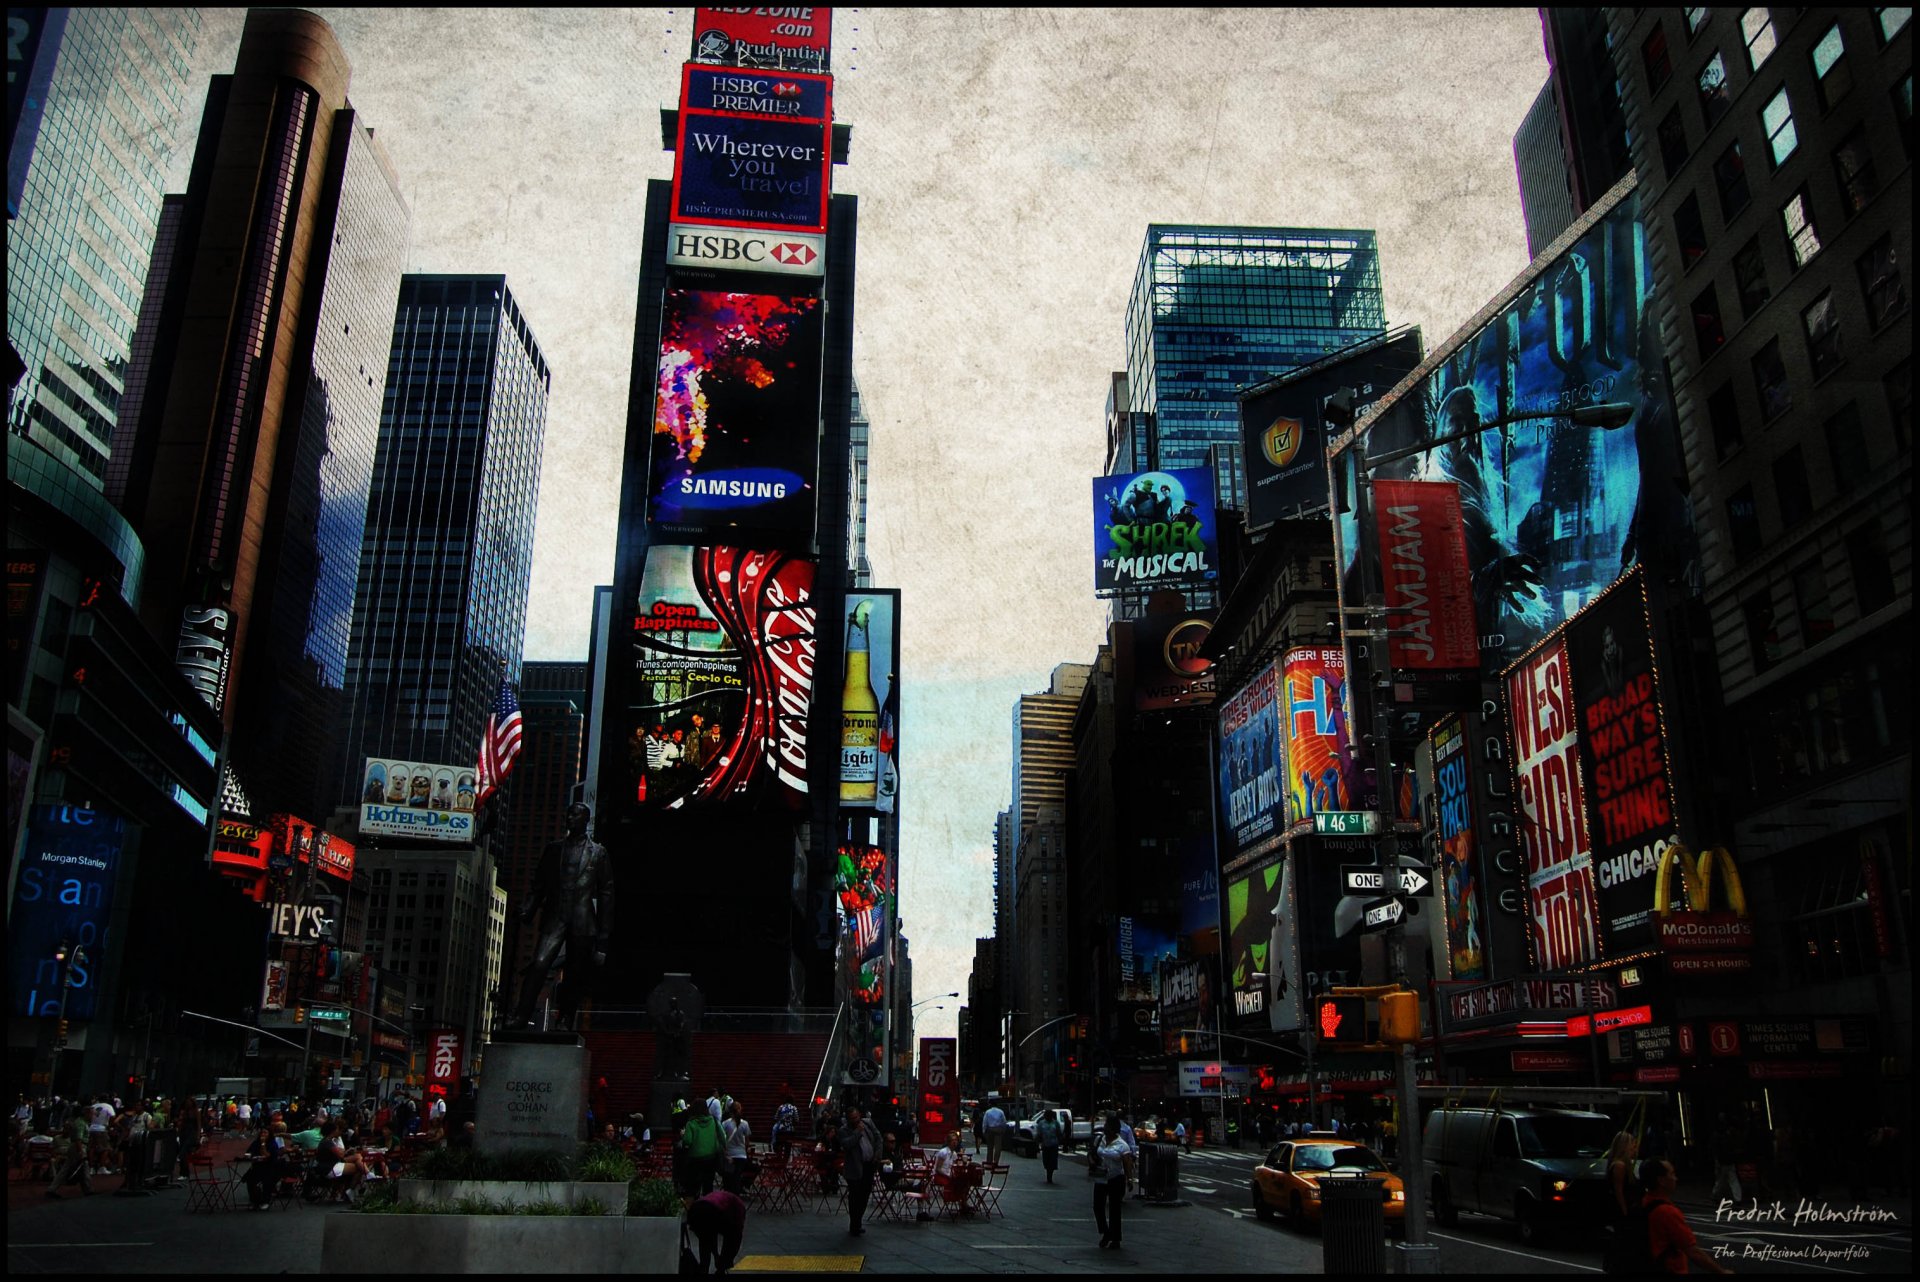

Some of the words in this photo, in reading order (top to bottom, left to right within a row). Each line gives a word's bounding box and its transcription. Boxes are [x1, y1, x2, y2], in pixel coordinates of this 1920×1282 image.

[770, 23, 813, 37] .com
[734, 39, 826, 60] Prudential
[712, 76, 768, 95] HSBC
[712, 94, 801, 115] PREMIER
[693, 132, 815, 161] Wherever
[729, 158, 775, 177] you
[740, 175, 809, 196] travel
[675, 234, 766, 262] HSBC
[1536, 418, 1578, 446] PRINC
[681, 478, 786, 499] SAMSUNG
[1445, 494, 1460, 533] WORLD
[1105, 519, 1206, 558] SHREK
[1449, 536, 1464, 558] THE
[1102, 559, 1115, 569] THE
[1114, 552, 1209, 581] MUSICAL
[1453, 563, 1466, 577] OF
[1386, 505, 1435, 661] JAMJAM
[1438, 570, 1457, 618] SQUARE
[652, 601, 698, 617] Open
[633, 615, 720, 631] Happiness
[1455, 580, 1475, 659] CROSSROADS
[1172, 641, 1201, 660] TN
[1444, 623, 1460, 660] TIMES
[1322, 650, 1344, 661] BES
[1324, 661, 1343, 669] 200
[635, 660, 737, 672] iTunes.com/openhappiness
[215, 648, 230, 711] Chocolate
[641, 673, 681, 682] Featuring
[1221, 696, 1239, 721] THE
[1241, 665, 1275, 707] CROWD
[1586, 671, 1654, 733] BROAD
[1223, 707, 1248, 738] GOES
[1250, 684, 1275, 717] WILD!
[1508, 648, 1577, 767] WEST
[841, 713, 878, 728] orona
[1590, 701, 1658, 762] WAY'S
[1595, 735, 1664, 800] SURE
[1228, 777, 1257, 830] JERSEY
[1257, 764, 1280, 812] BOYS
[1482, 700, 1518, 912] PALACE
[367, 806, 416, 825] HOTEL
[1250, 811, 1273, 832] MUSICAL
[1600, 776, 1672, 847] THING
[1316, 814, 1326, 832] W
[1330, 814, 1346, 832] 46
[1349, 814, 1359, 824] ST
[1321, 837, 1368, 853] Tonight
[41, 852, 77, 865] Morgan
[78, 855, 107, 870] Stanley
[1355, 875, 1381, 887] ONE
[1400, 876, 1419, 887] AY
[1368, 911, 1382, 924] ONE
[1386, 904, 1399, 917] WAY
[1120, 916, 1135, 962] AVENGER
[1662, 923, 1752, 935] McDonald's
[1677, 936, 1737, 945] Restaurant
[1121, 963, 1135, 983] THE
[1672, 960, 1700, 969] OPEN
[1702, 960, 1715, 969] 24
[1717, 960, 1751, 969] HOURS
[1621, 969, 1641, 985] FUEL
[1450, 992, 1470, 1022] WEST
[1472, 989, 1490, 1017] SIDE
[1493, 982, 1516, 1015] STORY
[1526, 979, 1577, 1009] WEST
[1572, 1020, 1588, 1031] THE
[1595, 1016, 1615, 1029] ODY
[1617, 1012, 1644, 1026] SHOP
[1744, 1024, 1774, 1033] TIMES
[1776, 1023, 1810, 1033] SQUARE
[1634, 1028, 1650, 1039] TIMES
[1651, 1025, 1671, 1037] SQUARE
[1749, 1032, 1810, 1043] INFORMATION
[1637, 1037, 1671, 1050] INFORMATION
[1762, 1043, 1798, 1053] CENTER
[434, 1033, 459, 1079] tkts
[928, 1040, 950, 1088] tkts
[1644, 1049, 1665, 1061] CENTER
[505, 1081, 552, 1093] GEORGE
[507, 1101, 548, 1113] COHAN
